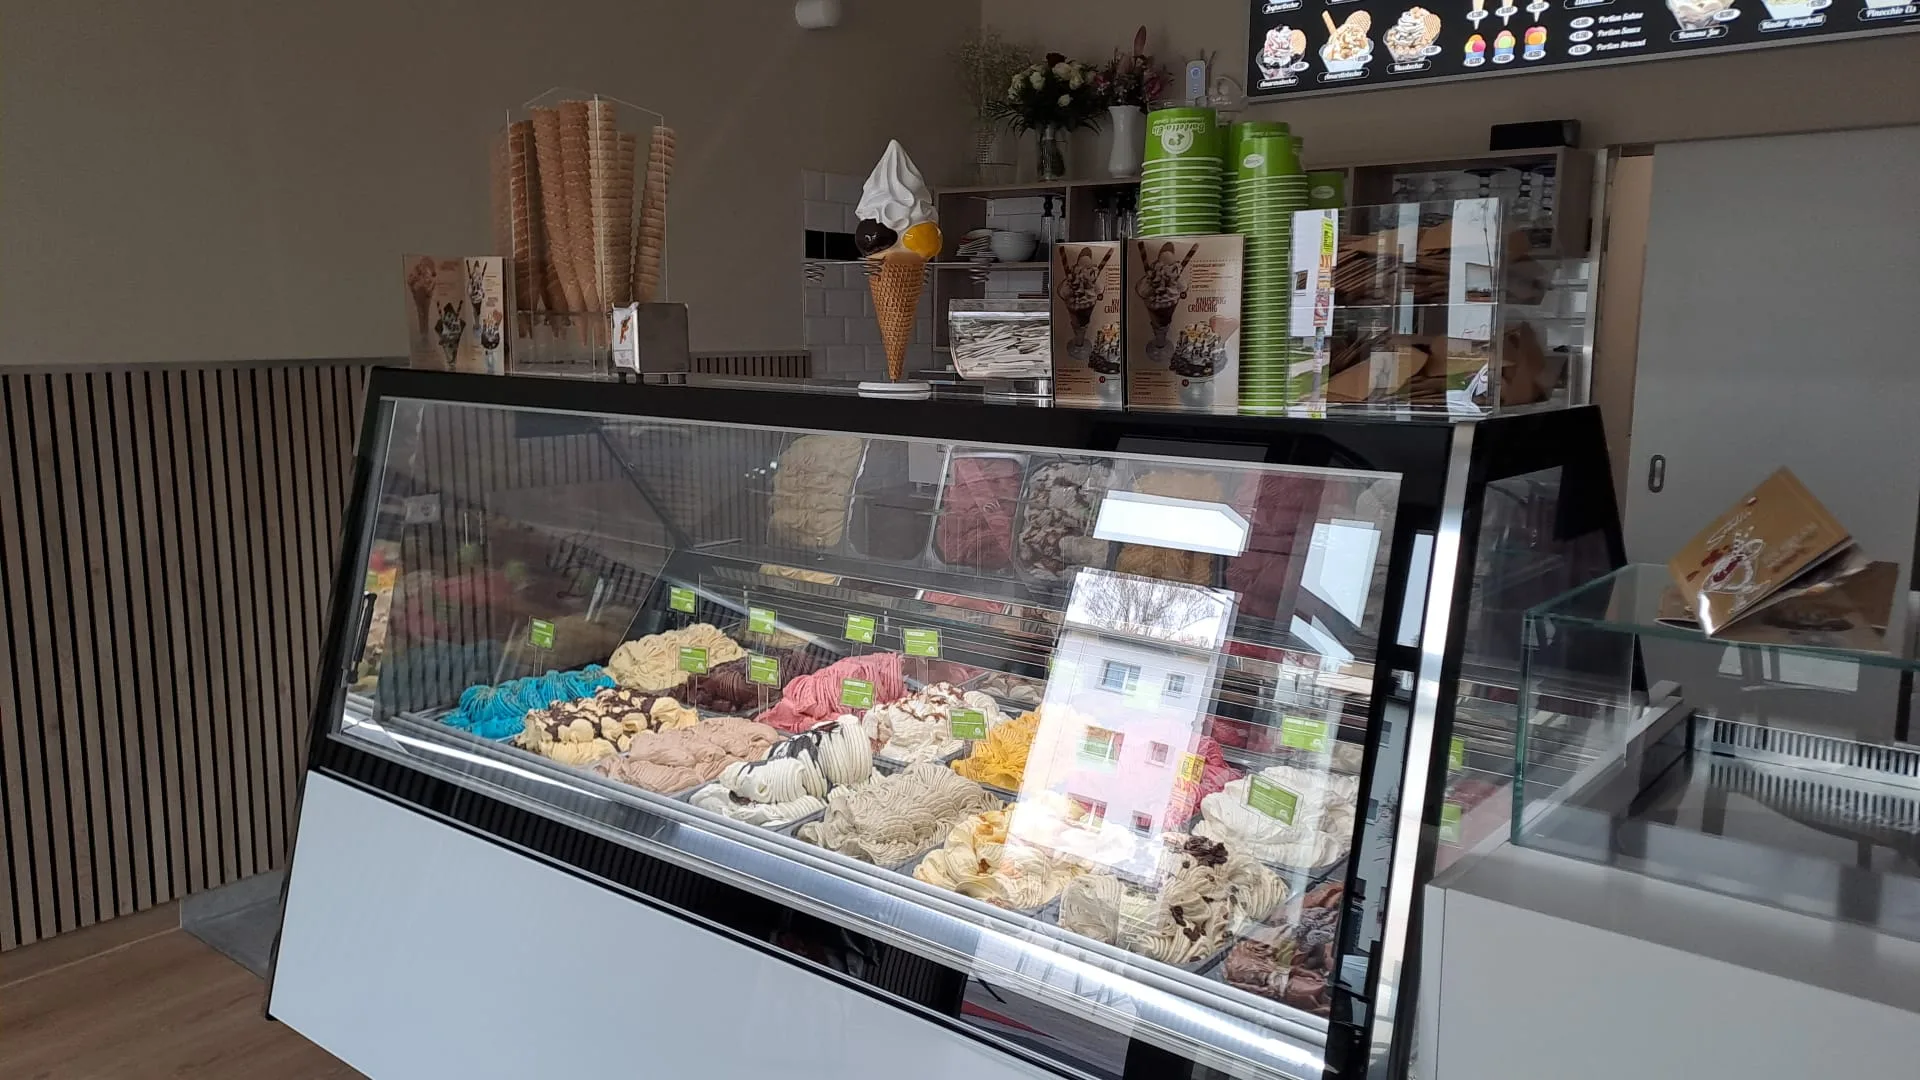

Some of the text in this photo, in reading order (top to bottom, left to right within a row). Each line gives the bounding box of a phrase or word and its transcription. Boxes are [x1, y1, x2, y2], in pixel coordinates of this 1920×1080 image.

[1598, 15, 1621, 23] Portion
[1597, 29, 1620, 37] Portion
[1596, 43, 1620, 51] Portion
